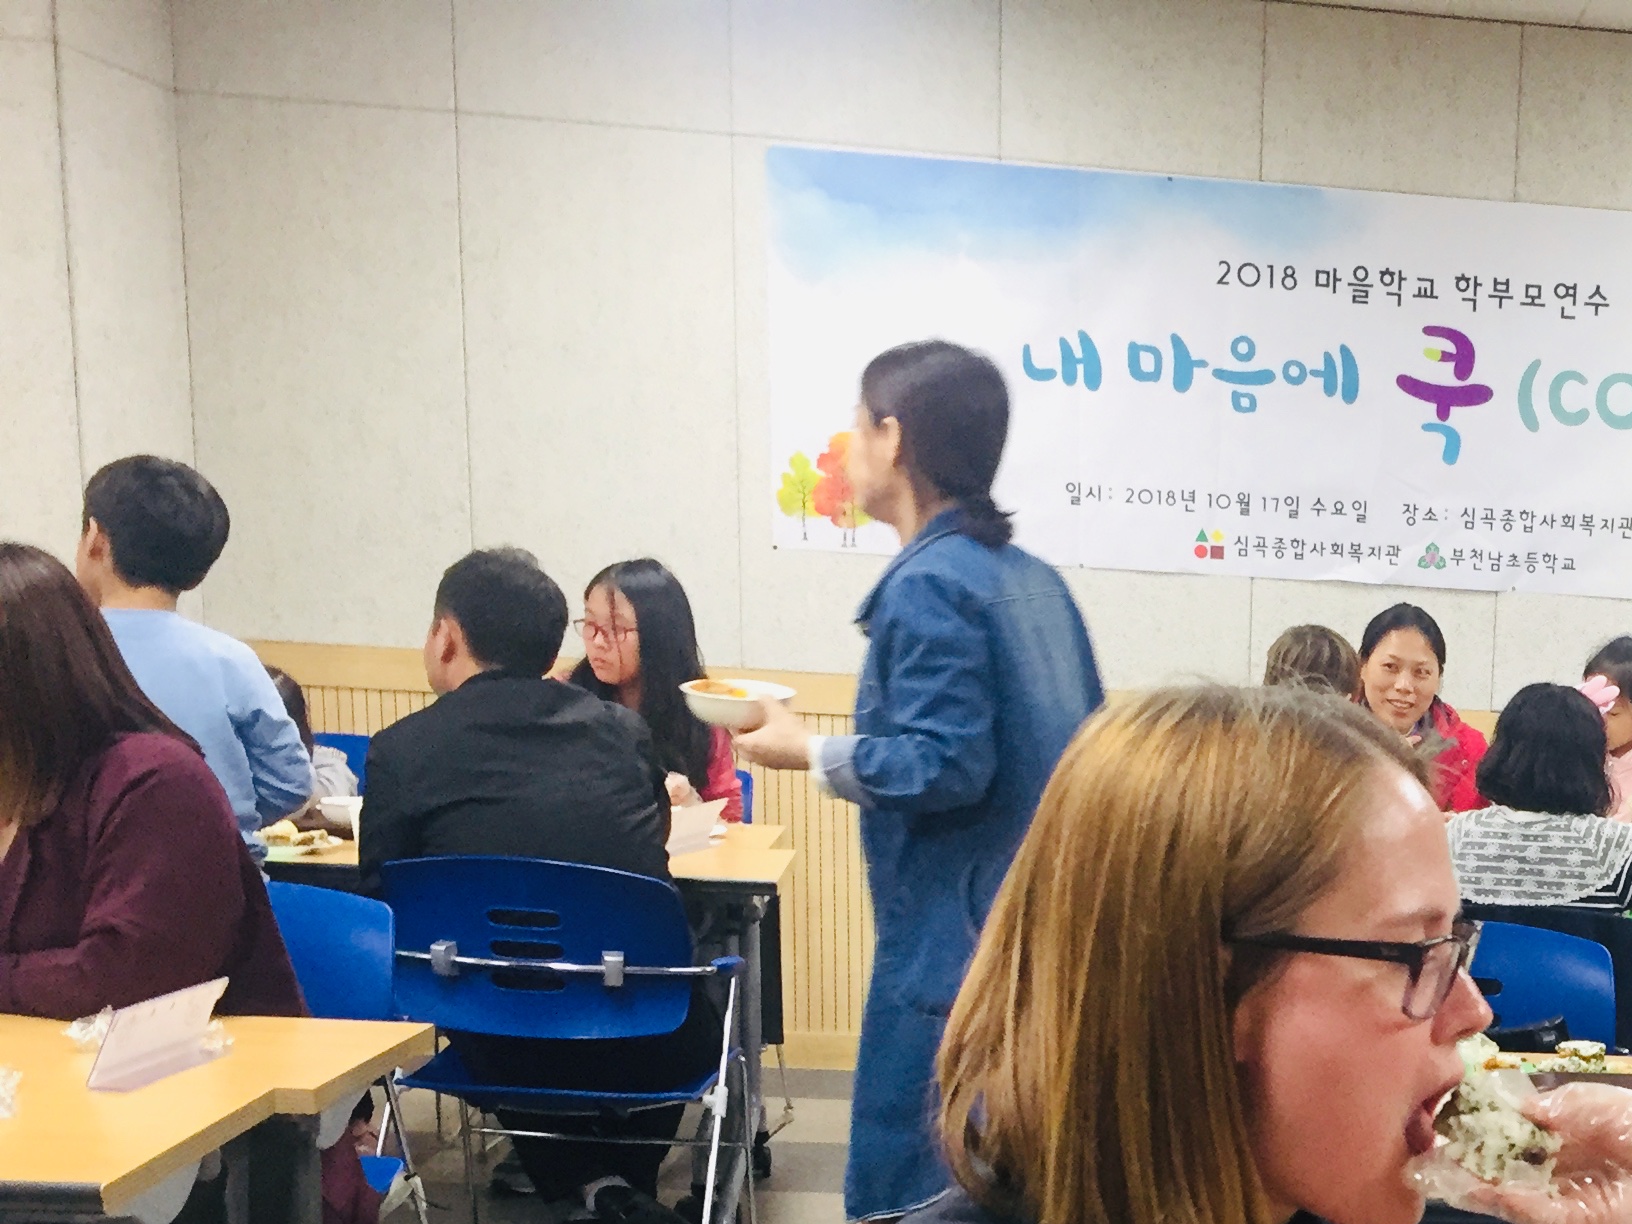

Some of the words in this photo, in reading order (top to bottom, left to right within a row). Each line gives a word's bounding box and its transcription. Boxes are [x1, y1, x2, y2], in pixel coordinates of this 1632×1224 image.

[1217, 261, 1297, 290] 2018
[1315, 266, 1438, 307] 마을학교
[1455, 273, 1609, 319] 학부모연수
[1022, 329, 1102, 391] 내
[1127, 333, 1359, 413] 마음에
[1396, 325, 1494, 465] 쿡
[1126, 488, 1195, 512] 2018년
[1208, 492, 1250, 516] 10월
[1262, 496, 1299, 519] 17일
[1310, 497, 1367, 523] 수요일
[1234, 536, 1401, 566] 심곡종합사회복지관
[1450, 548, 1576, 574] 부천남초등학교
